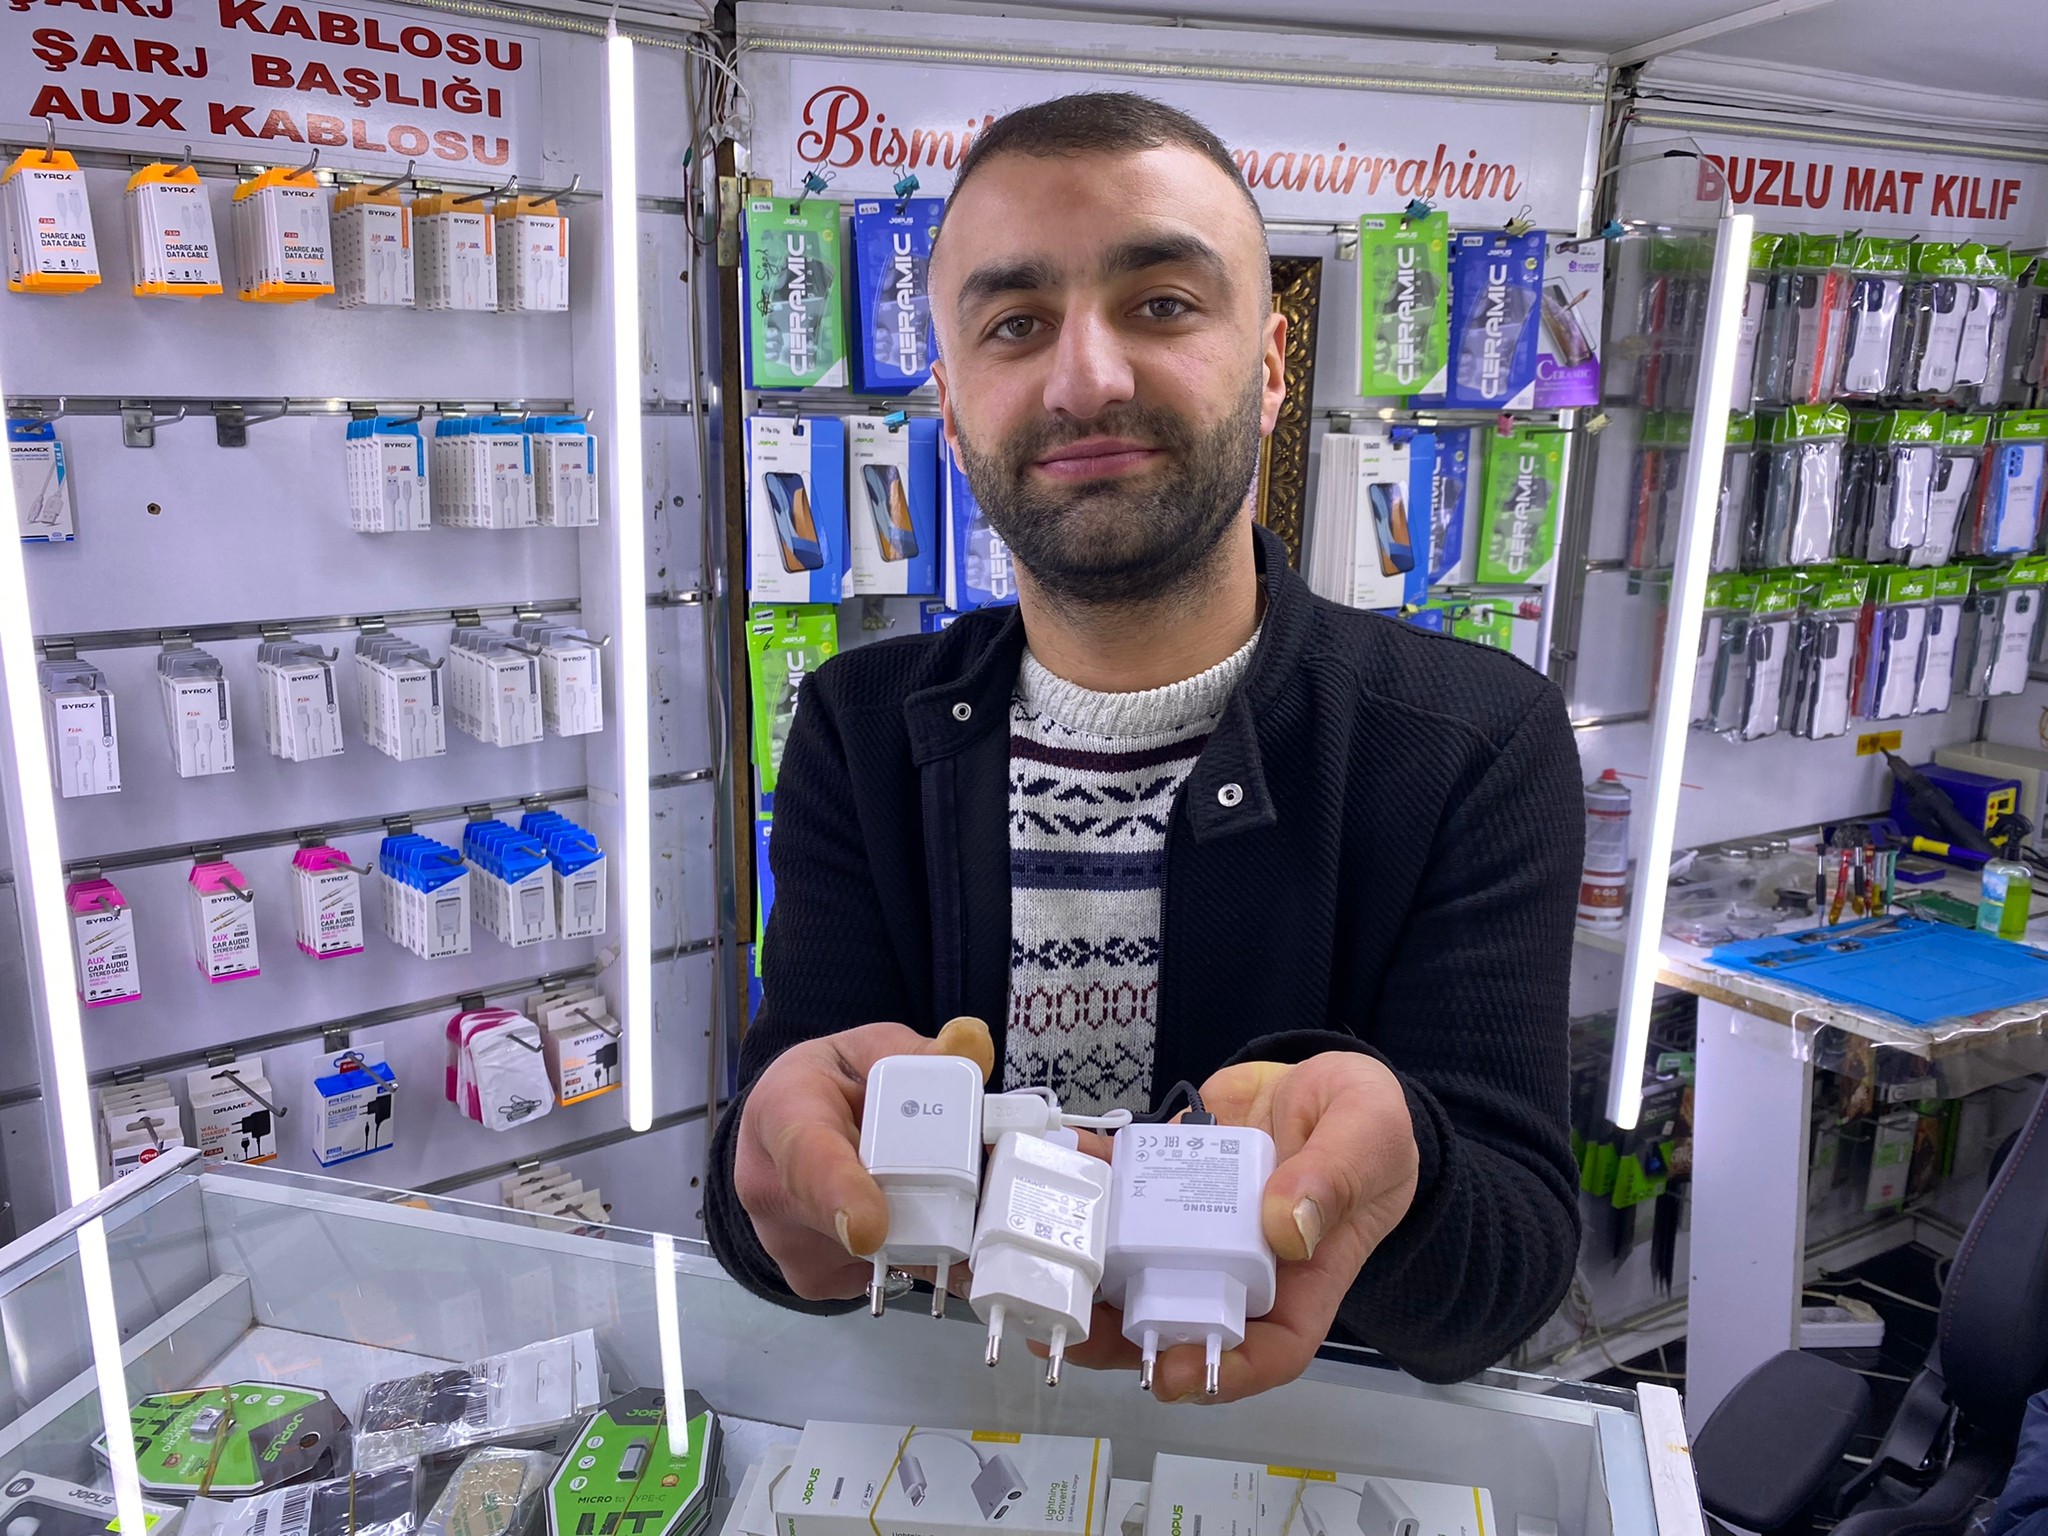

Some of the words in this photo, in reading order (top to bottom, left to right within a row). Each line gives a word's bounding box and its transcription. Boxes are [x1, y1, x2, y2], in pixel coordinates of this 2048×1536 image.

[218, 0, 522, 71] KABLOSU
[32, 28, 208, 79] ŞARJ
[251, 53, 502, 118] BAŞLIĞI
[29, 85, 187, 131] AUX
[208, 102, 509, 166] KABLOSU
[33, 172, 72, 181] SYROX
[160, 185, 196, 194] SYROX
[1696, 154, 1833, 210] BUZLU
[1843, 166, 1923, 215] MAT
[1930, 174, 2022, 220] KILIF
[282, 190, 315, 198] SYROX
[368, 209, 396, 217] SYROX
[889, 217, 913, 225] JOPUS
[40, 232, 69, 240] CHARGE
[787, 234, 807, 377] CERAMIC
[893, 232, 918, 377] CERAMIC
[1397, 247, 1415, 386] CERAMIC
[1481, 264, 1508, 400] CERAMIC
[1508, 456, 1535, 575] CERAMIC
[291, 674, 320, 682] SYROX
[400, 675, 427, 683] SYROX
[320, 875, 349, 884] SYROX
[211, 893, 240, 904] SYROX
[85, 916, 120, 925] SYROX
[320, 912, 336, 920] AUX
[321, 919, 335, 927] CAR
[336, 915, 355, 924] AUDIO
[212, 933, 228, 942] AUX
[212, 941, 227, 949] CAR
[229, 937, 250, 946] AUDIO
[517, 937, 543, 945] SYROX
[213, 946, 233, 954] STEREO
[431, 950, 457, 958] SYROX
[87, 957, 105, 966] AUX
[88, 964, 104, 972] CAR
[105, 960, 129, 970] AUDIO
[89, 970, 110, 978] STEREO
[111, 967, 129, 976] CABLE
[574, 1033, 605, 1046] SYROX
[213, 1100, 254, 1114] DRAMEX
[328, 1104, 358, 1116] CHARGER
[923, 1103, 943, 1116] LG
[201, 1127, 230, 1138] CHARGER
[1183, 1203, 1238, 1214] SAMSUNG
[162, 1426, 189, 1452] MICRO
[264, 1413, 304, 1462] JOPUS
[802, 1468, 820, 1505] JOPUS
[69, 1489, 116, 1505] JOPUS
[577, 1495, 612, 1504] MICRO
[615, 1495, 626, 1503] to
[1045, 1482, 1060, 1520] Lightning
[1056, 1480, 1068, 1521] Converter
